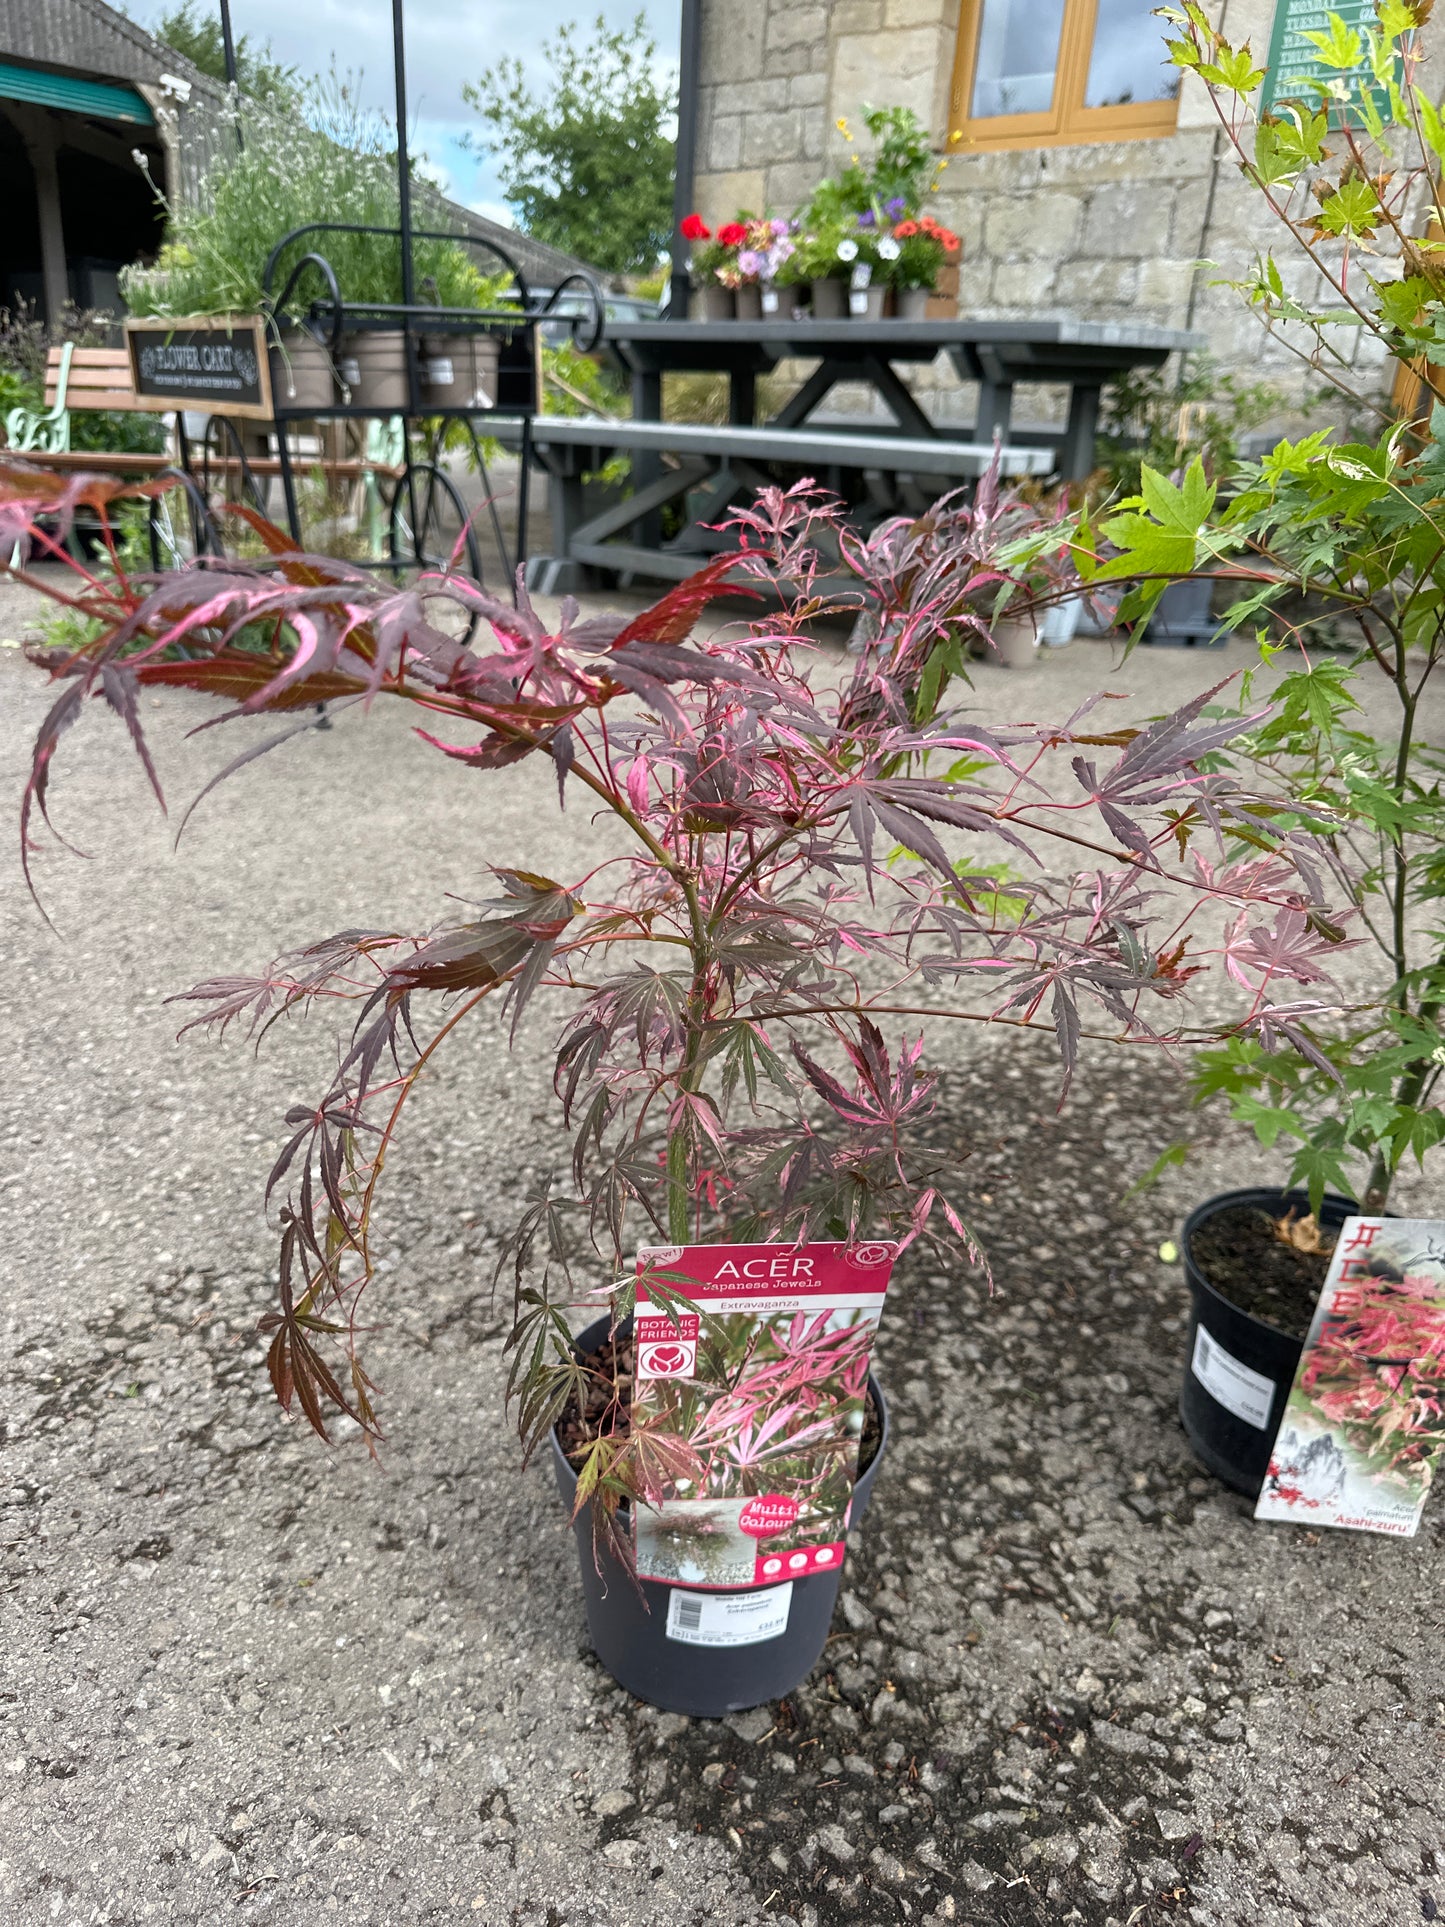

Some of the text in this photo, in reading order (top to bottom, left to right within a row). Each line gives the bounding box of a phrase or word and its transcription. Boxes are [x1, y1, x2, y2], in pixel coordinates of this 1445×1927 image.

[1285, 13, 1331, 30] TUESDA
[155, 345, 233, 372] FLOWER CART
[713, 1258, 815, 1279] ACER
[703, 1278, 822, 1293] Japanese Jewels
[720, 1299, 800, 1310] Extravaganza
[640, 1328, 696, 1340] FRIENDS
[750, 1501, 793, 1515] Multi
[740, 1515, 793, 1529] Colour
